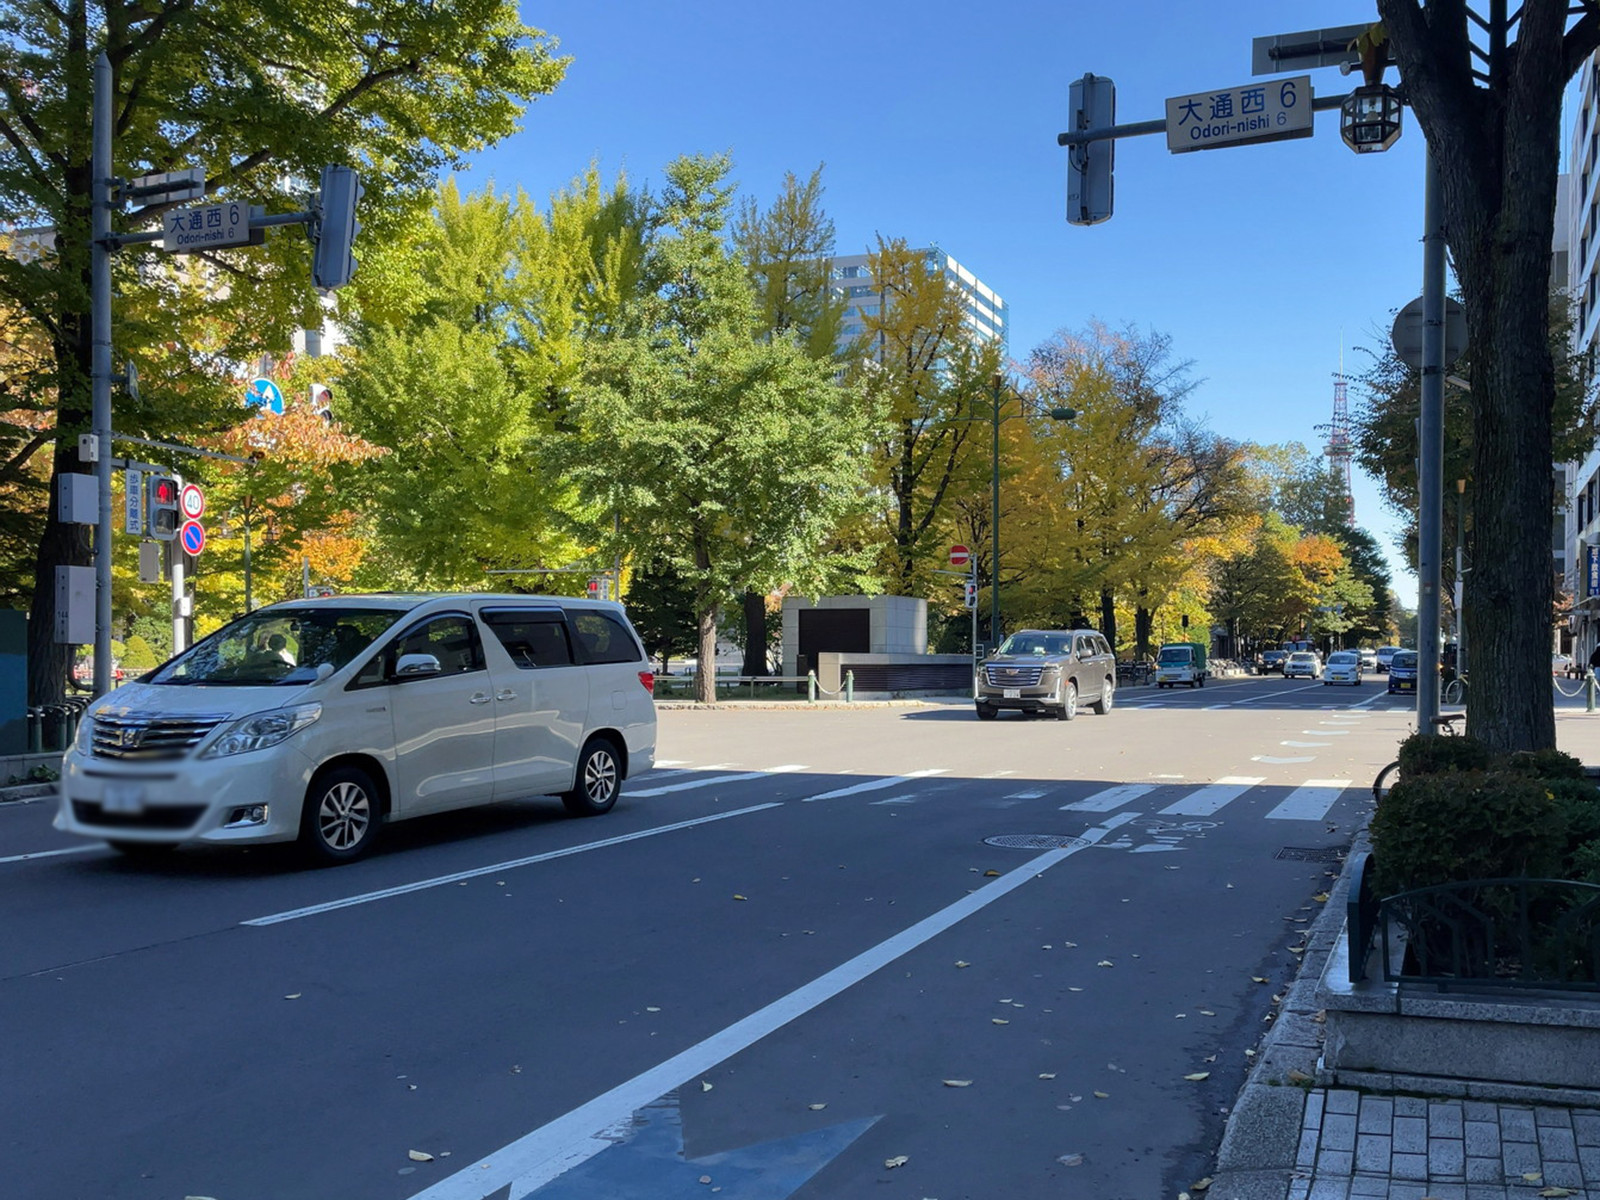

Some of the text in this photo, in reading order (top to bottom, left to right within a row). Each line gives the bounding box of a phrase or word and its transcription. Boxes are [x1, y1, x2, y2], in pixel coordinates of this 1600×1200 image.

[1178, 81, 1297, 126] 大通西 6
[1190, 111, 1287, 140] Odori-nishi 6
[177, 227, 235, 245] Odori-nishi 6
[187, 494, 199, 510] 40
